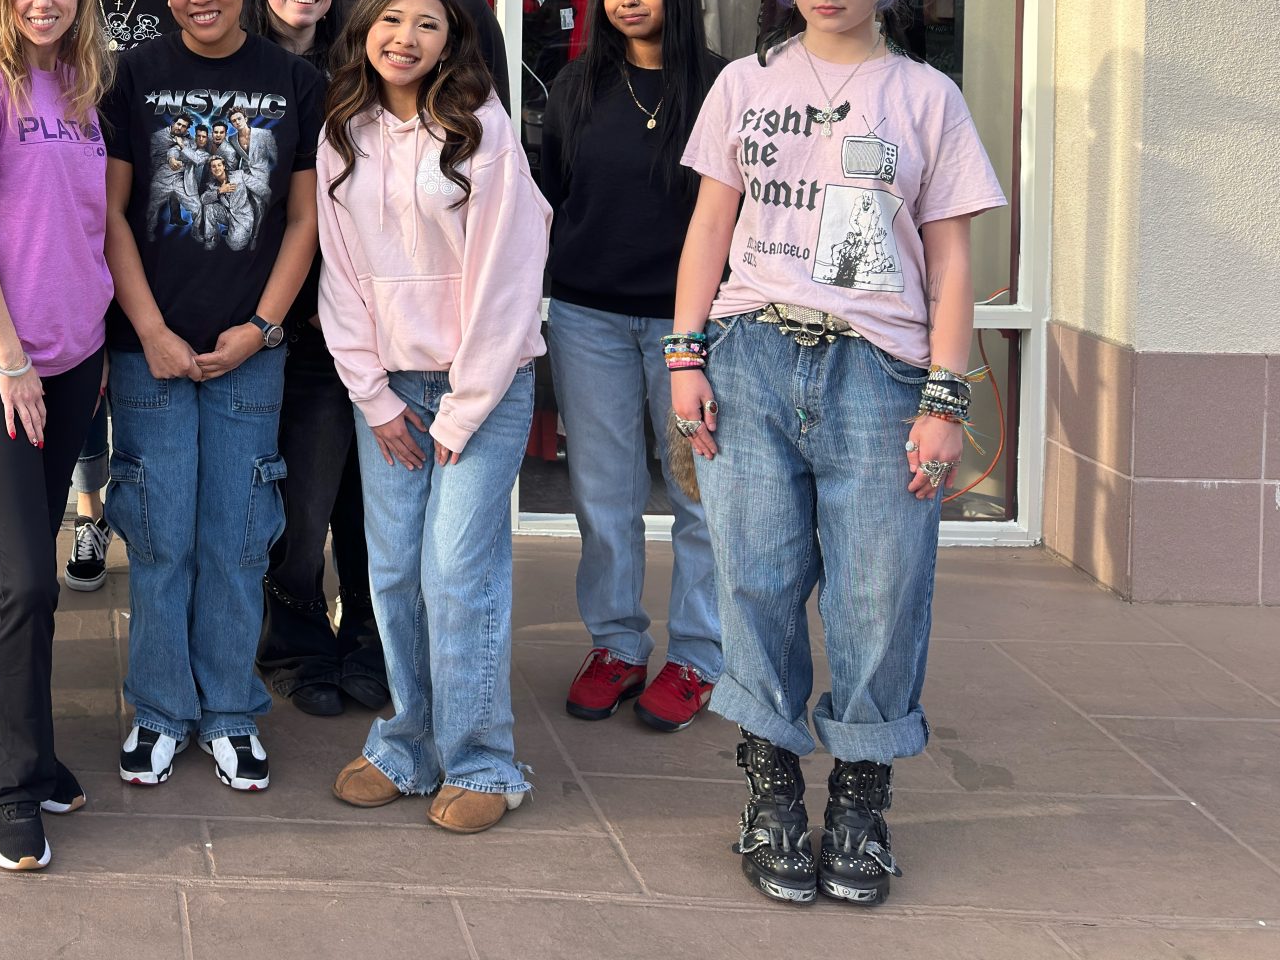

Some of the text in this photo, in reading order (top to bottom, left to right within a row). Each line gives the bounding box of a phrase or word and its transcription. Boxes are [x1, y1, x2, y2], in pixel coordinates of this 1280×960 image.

[83, 146, 105, 157] CLO
[739, 135, 779, 168] he
[744, 172, 823, 212] omit
